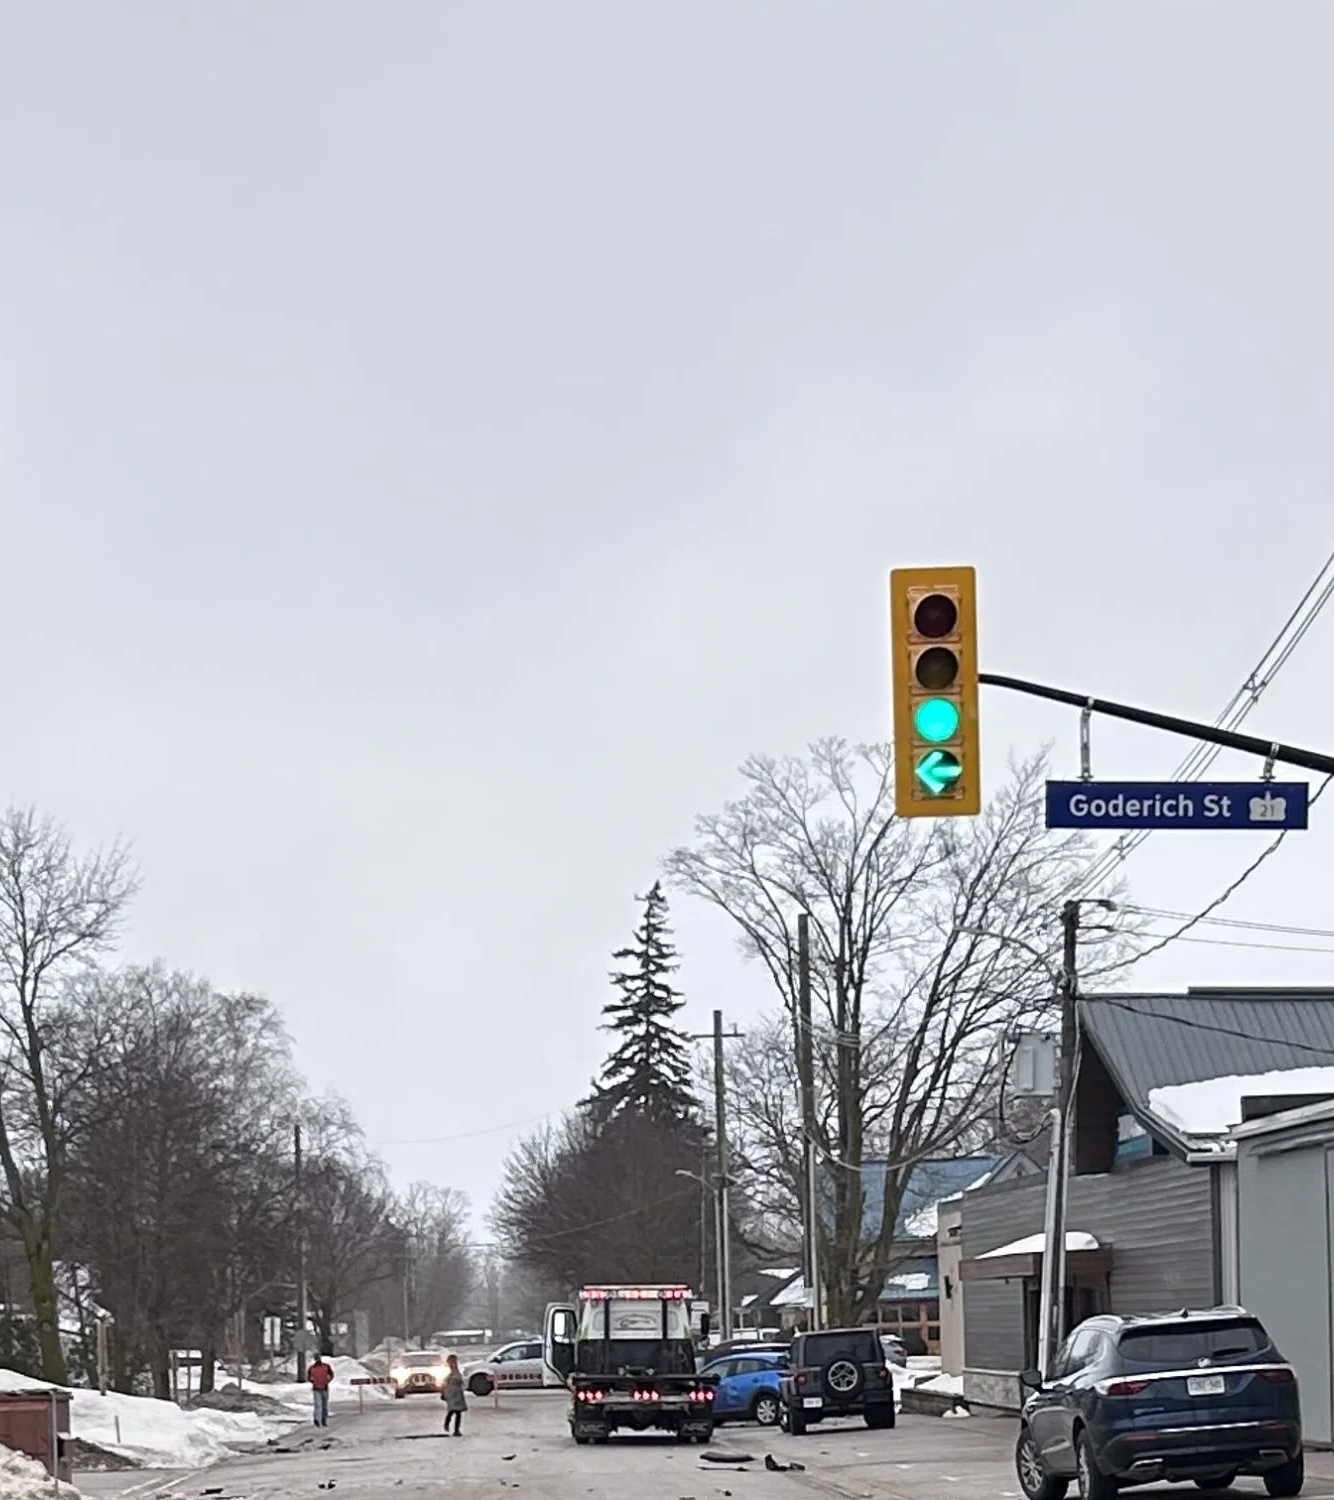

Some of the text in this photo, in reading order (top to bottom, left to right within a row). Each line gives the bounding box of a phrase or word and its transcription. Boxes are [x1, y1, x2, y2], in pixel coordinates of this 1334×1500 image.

[1069, 794, 1232, 817] Goderich St
[1259, 804, 1275, 818] 21
